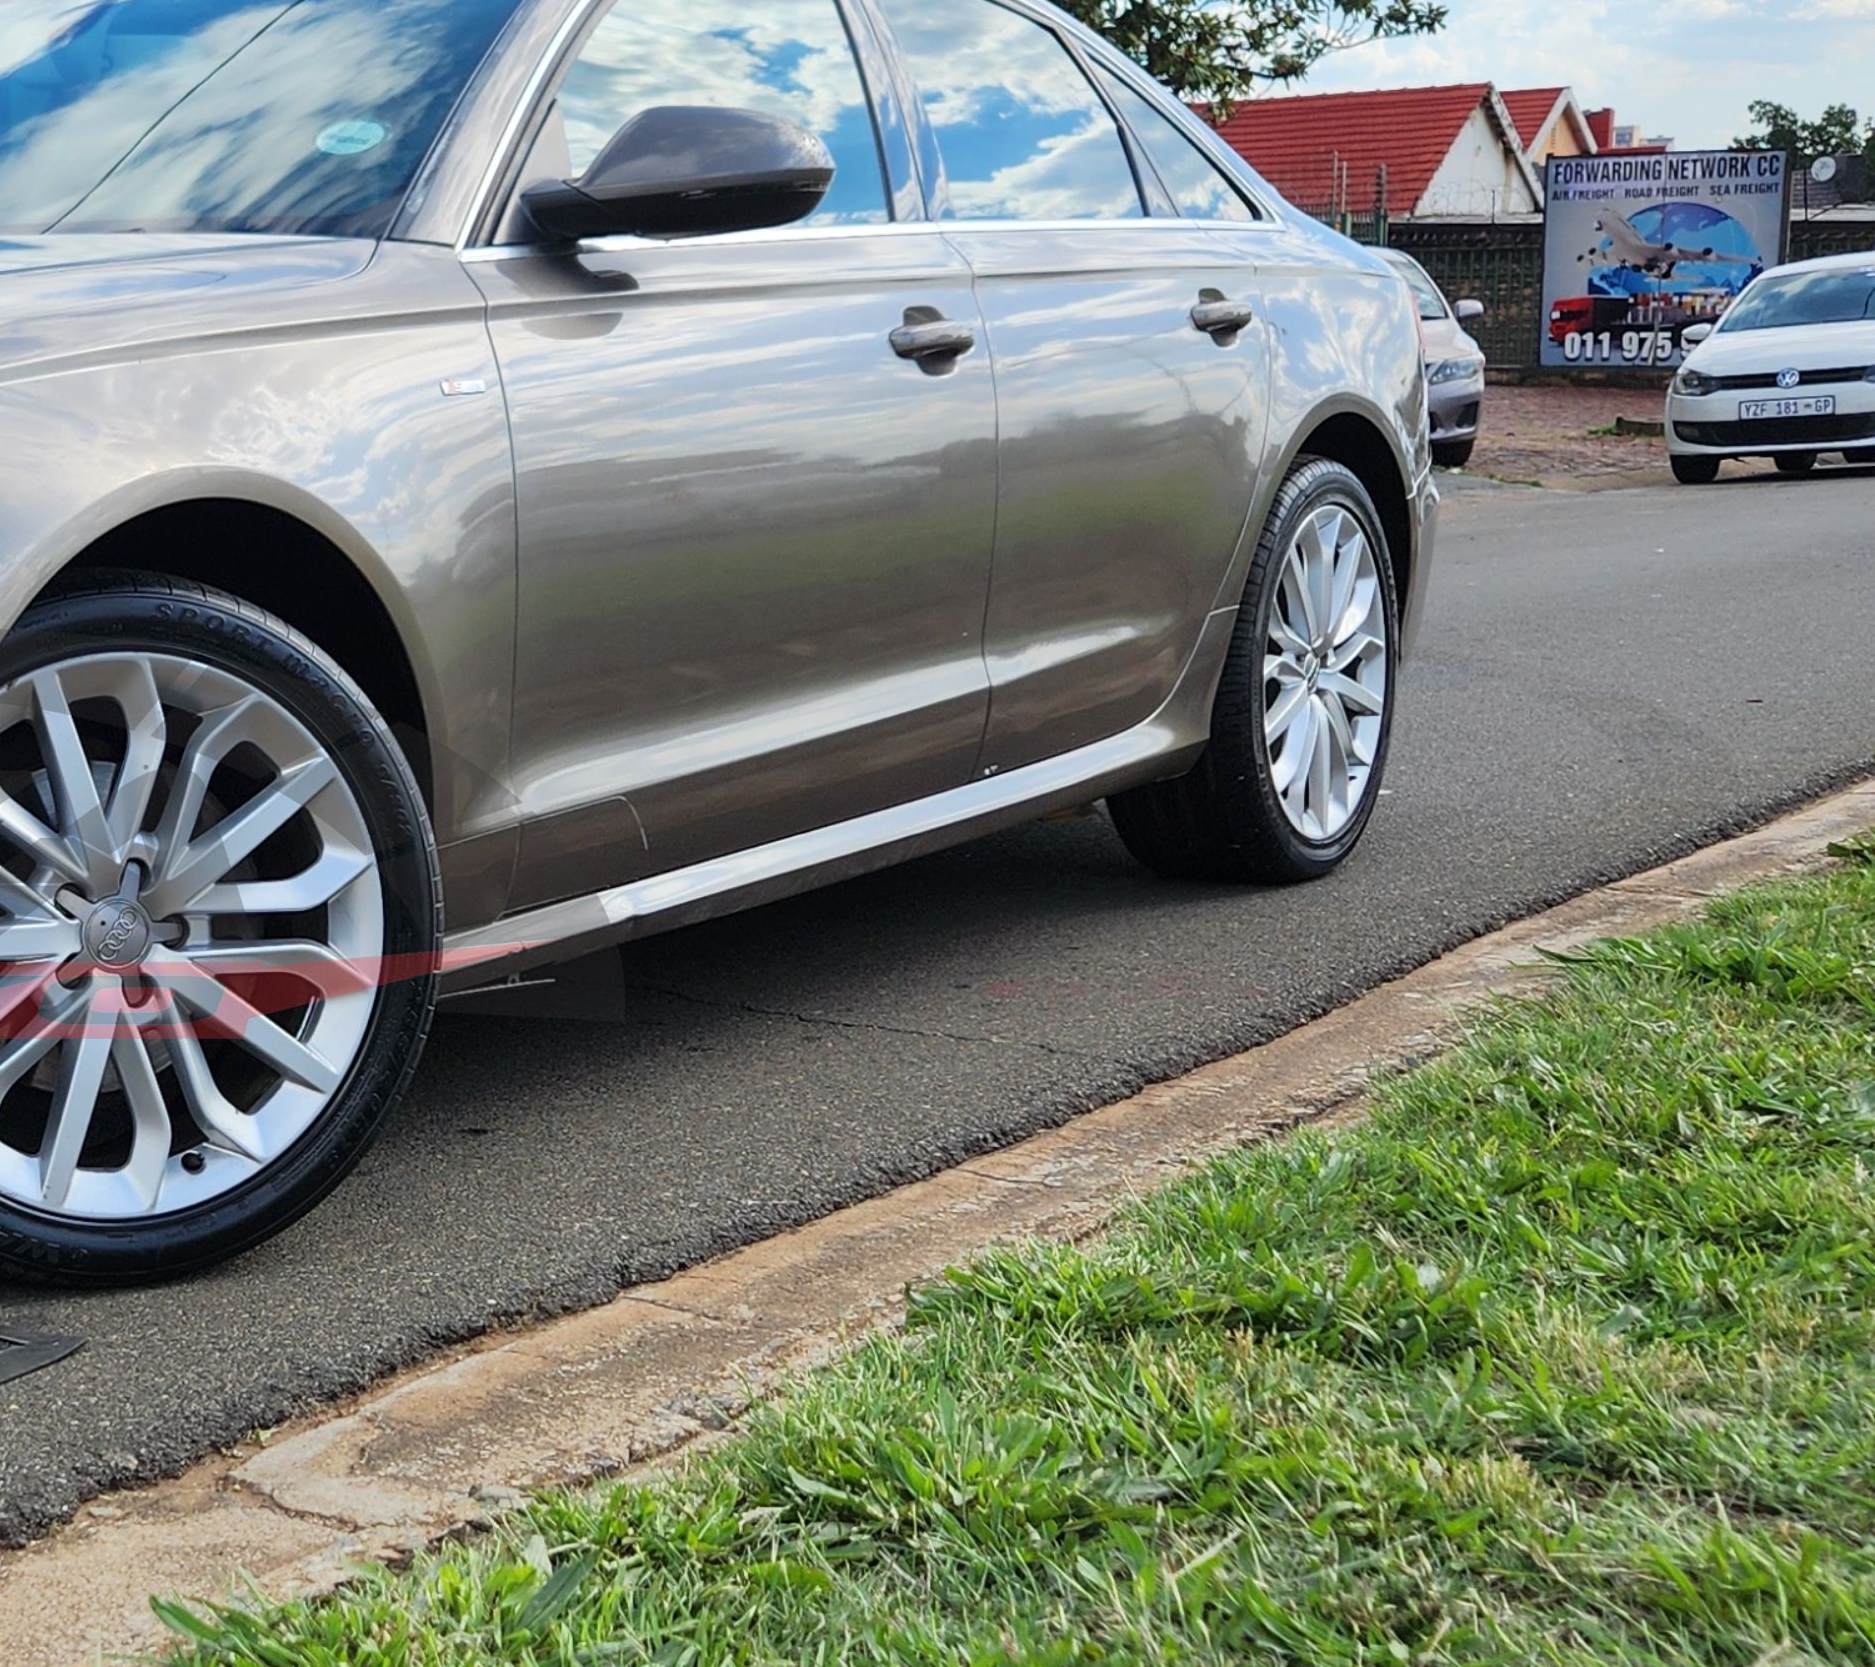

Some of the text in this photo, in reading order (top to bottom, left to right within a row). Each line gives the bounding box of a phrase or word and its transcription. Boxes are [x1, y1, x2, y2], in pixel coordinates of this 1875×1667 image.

[1554, 154, 1780, 184] FORWARDING NETWORK CC
[1551, 189, 1615, 201] AIR FREIGHT
[1625, 185, 1700, 199] ROAD FREIGHT
[1709, 182, 1780, 196] SEA FREIGHT
[1564, 331, 1611, 361] 011
[1622, 331, 1673, 361] 975
[1744, 399, 1831, 417] YZF 181 GP
[152, 602, 276, 652] SPORT
